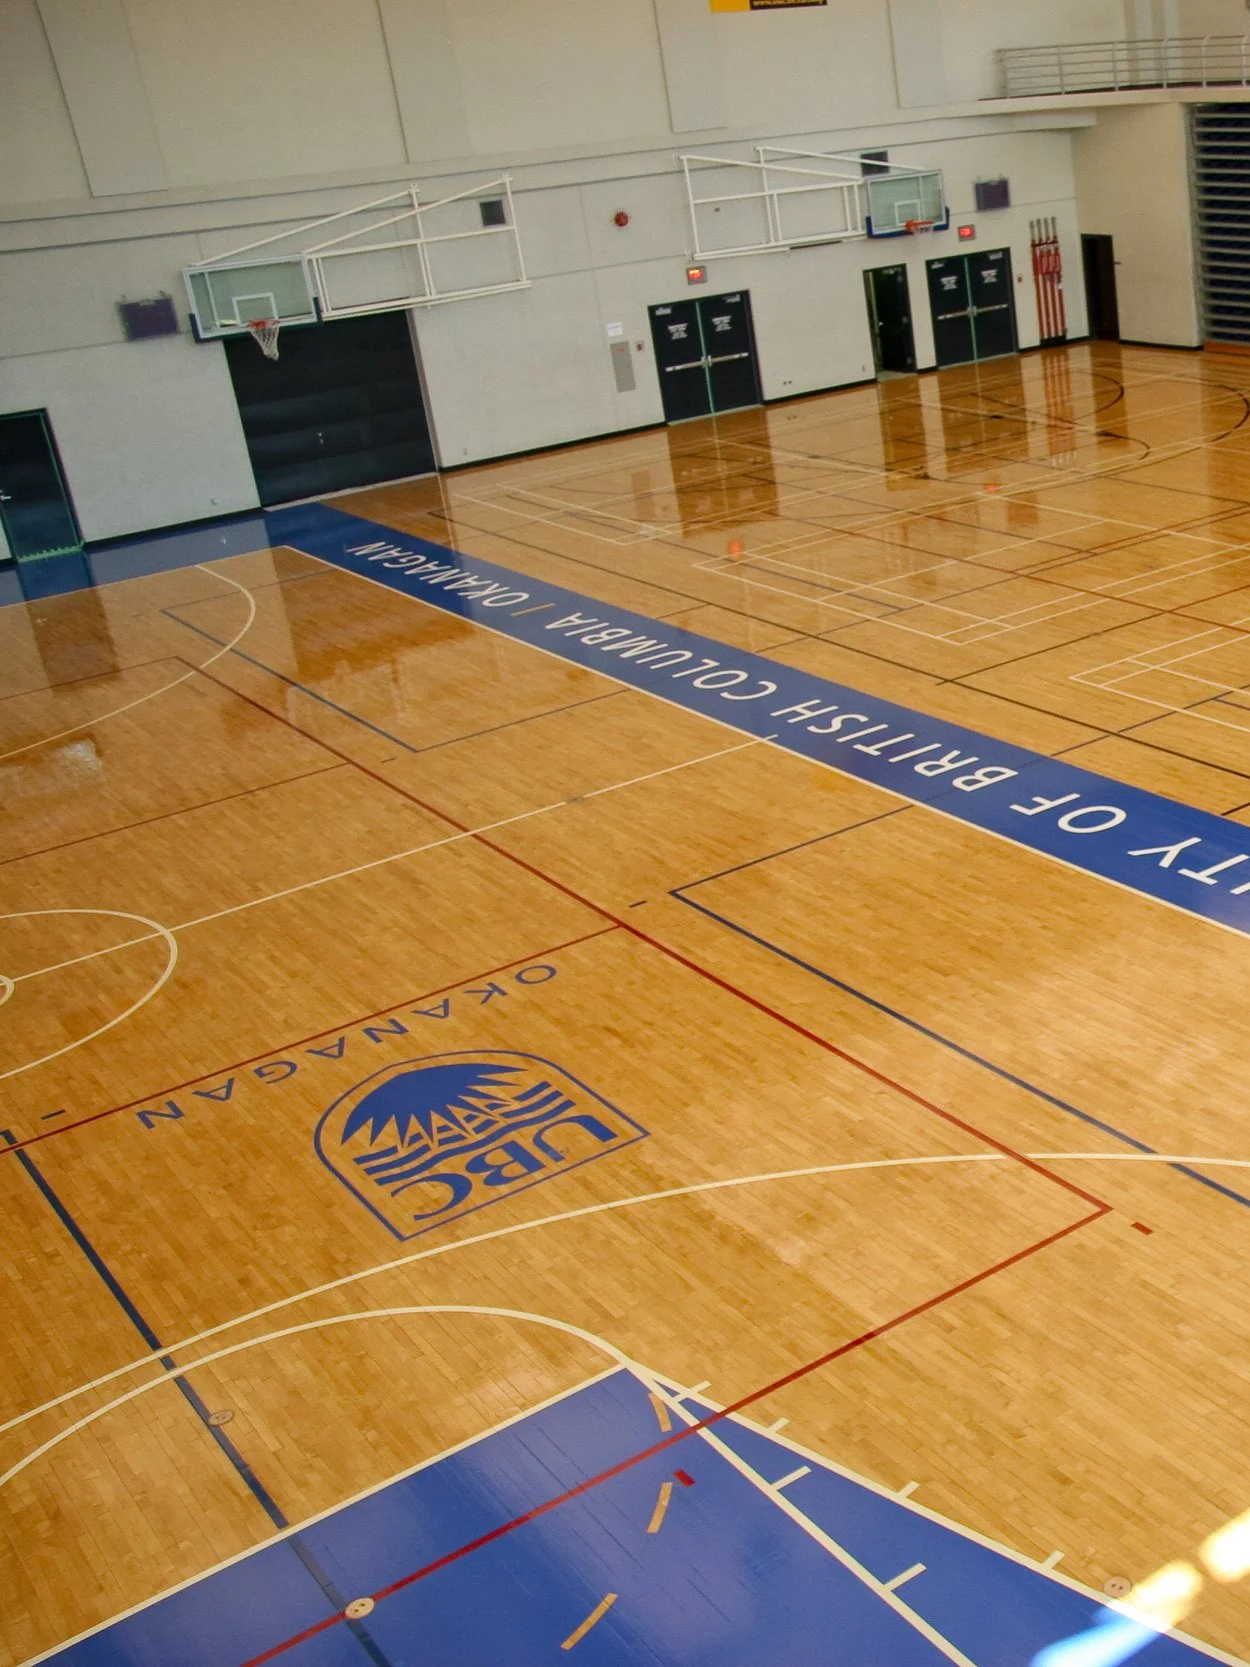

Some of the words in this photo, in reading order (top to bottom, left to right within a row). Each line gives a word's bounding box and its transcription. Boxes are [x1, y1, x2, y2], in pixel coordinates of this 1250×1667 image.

[347, 541, 531, 608] OKANAGAN
[545, 612, 778, 701] COLUMBIA
[770, 698, 1018, 793] BRITISH
[1010, 793, 1126, 834] OF
[137, 965, 557, 1129] OKANAGAN
[390, 1115, 618, 1222] UBC
